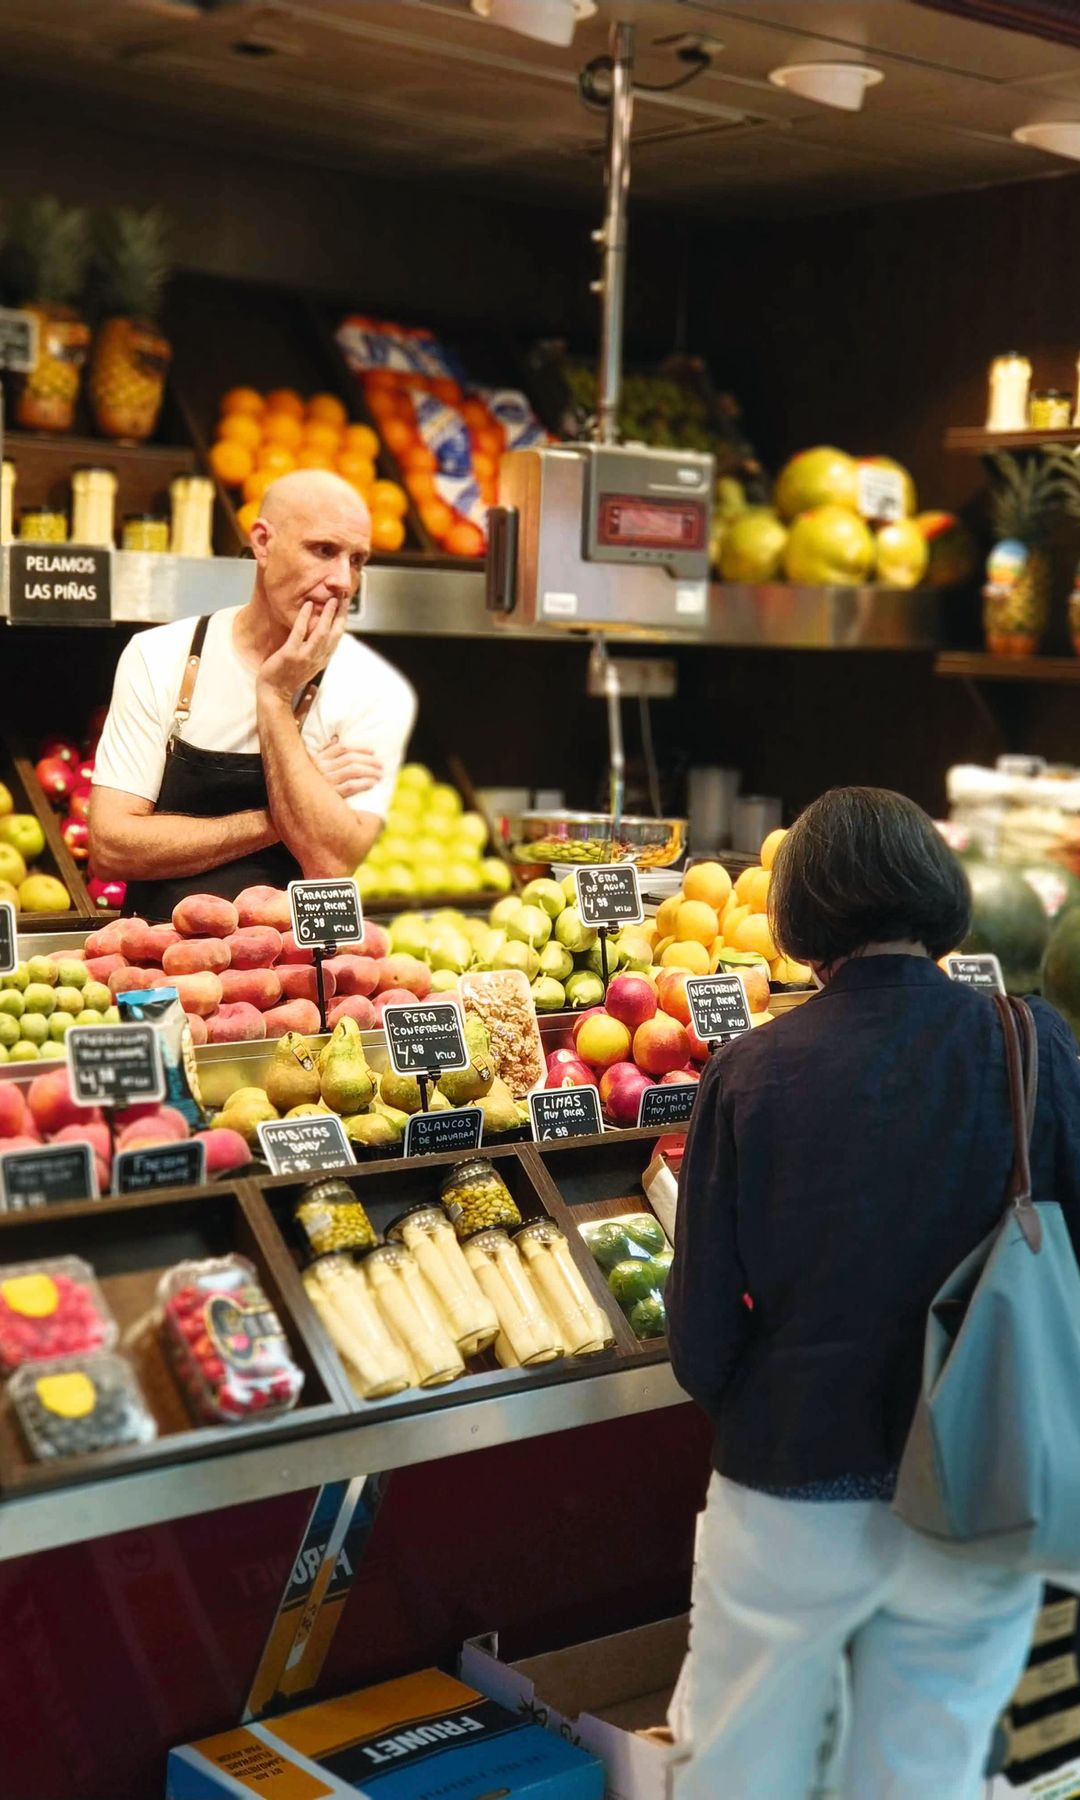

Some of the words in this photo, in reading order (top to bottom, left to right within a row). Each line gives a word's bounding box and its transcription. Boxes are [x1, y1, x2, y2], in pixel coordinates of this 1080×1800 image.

[26, 555, 96, 573] PELAMOS
[25, 583, 51, 599] LAS
[54, 581, 97, 600] PIÑAS
[589, 871, 618, 884] PERA
[333, 924, 355, 932] KILO
[403, 1012, 436, 1024] PERA
[435, 1051, 456, 1060] KILO
[543, 1095, 581, 1109] LIMAS
[649, 1092, 695, 1105] TOMATE
[417, 1118, 471, 1134] BLANCOS
[267, 1126, 330, 1143] HABITAS
[361, 1716, 486, 1764] FRUNET
